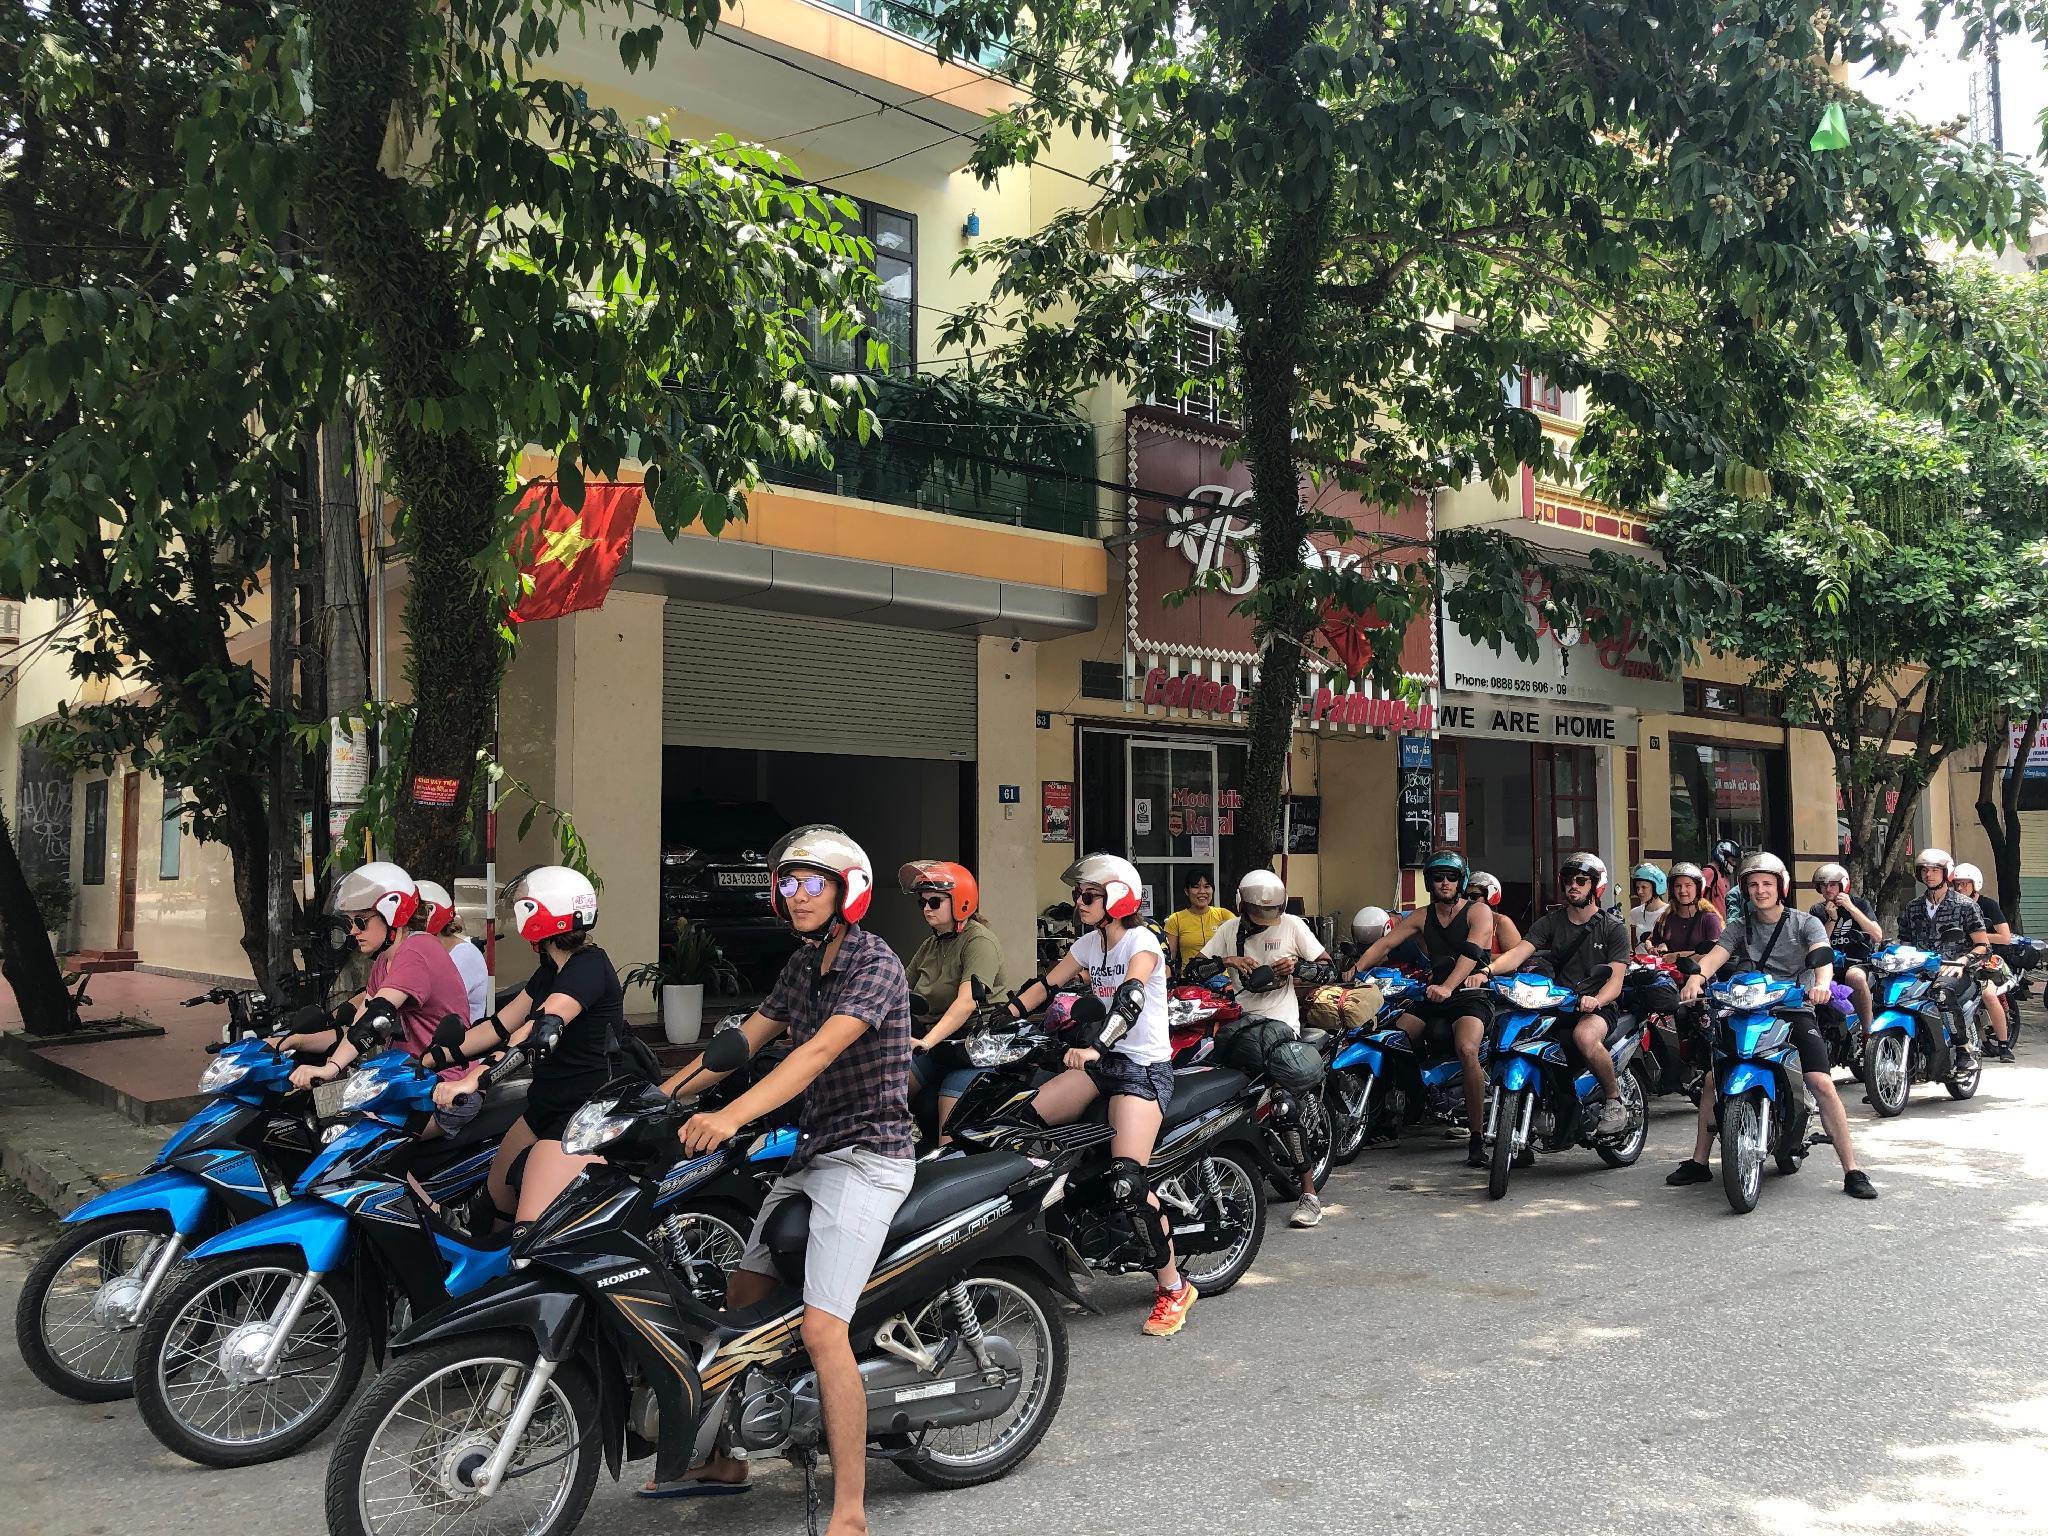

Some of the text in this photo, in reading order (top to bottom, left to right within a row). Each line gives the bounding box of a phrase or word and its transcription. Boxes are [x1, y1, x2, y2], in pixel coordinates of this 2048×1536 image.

[1455, 673, 1489, 688] Phone:
[1490, 679, 1513, 690] 0888
[1514, 680, 1531, 692] 526
[1532, 681, 1549, 693] 606
[1556, 684, 1567, 696] 09
[1036, 715, 1046, 726] 63
[1440, 706, 1616, 740] WE ARE HOME
[1651, 738, 1660, 748] 67
[1003, 788, 1015, 800] 61
[596, 1266, 652, 1288] HONDA
